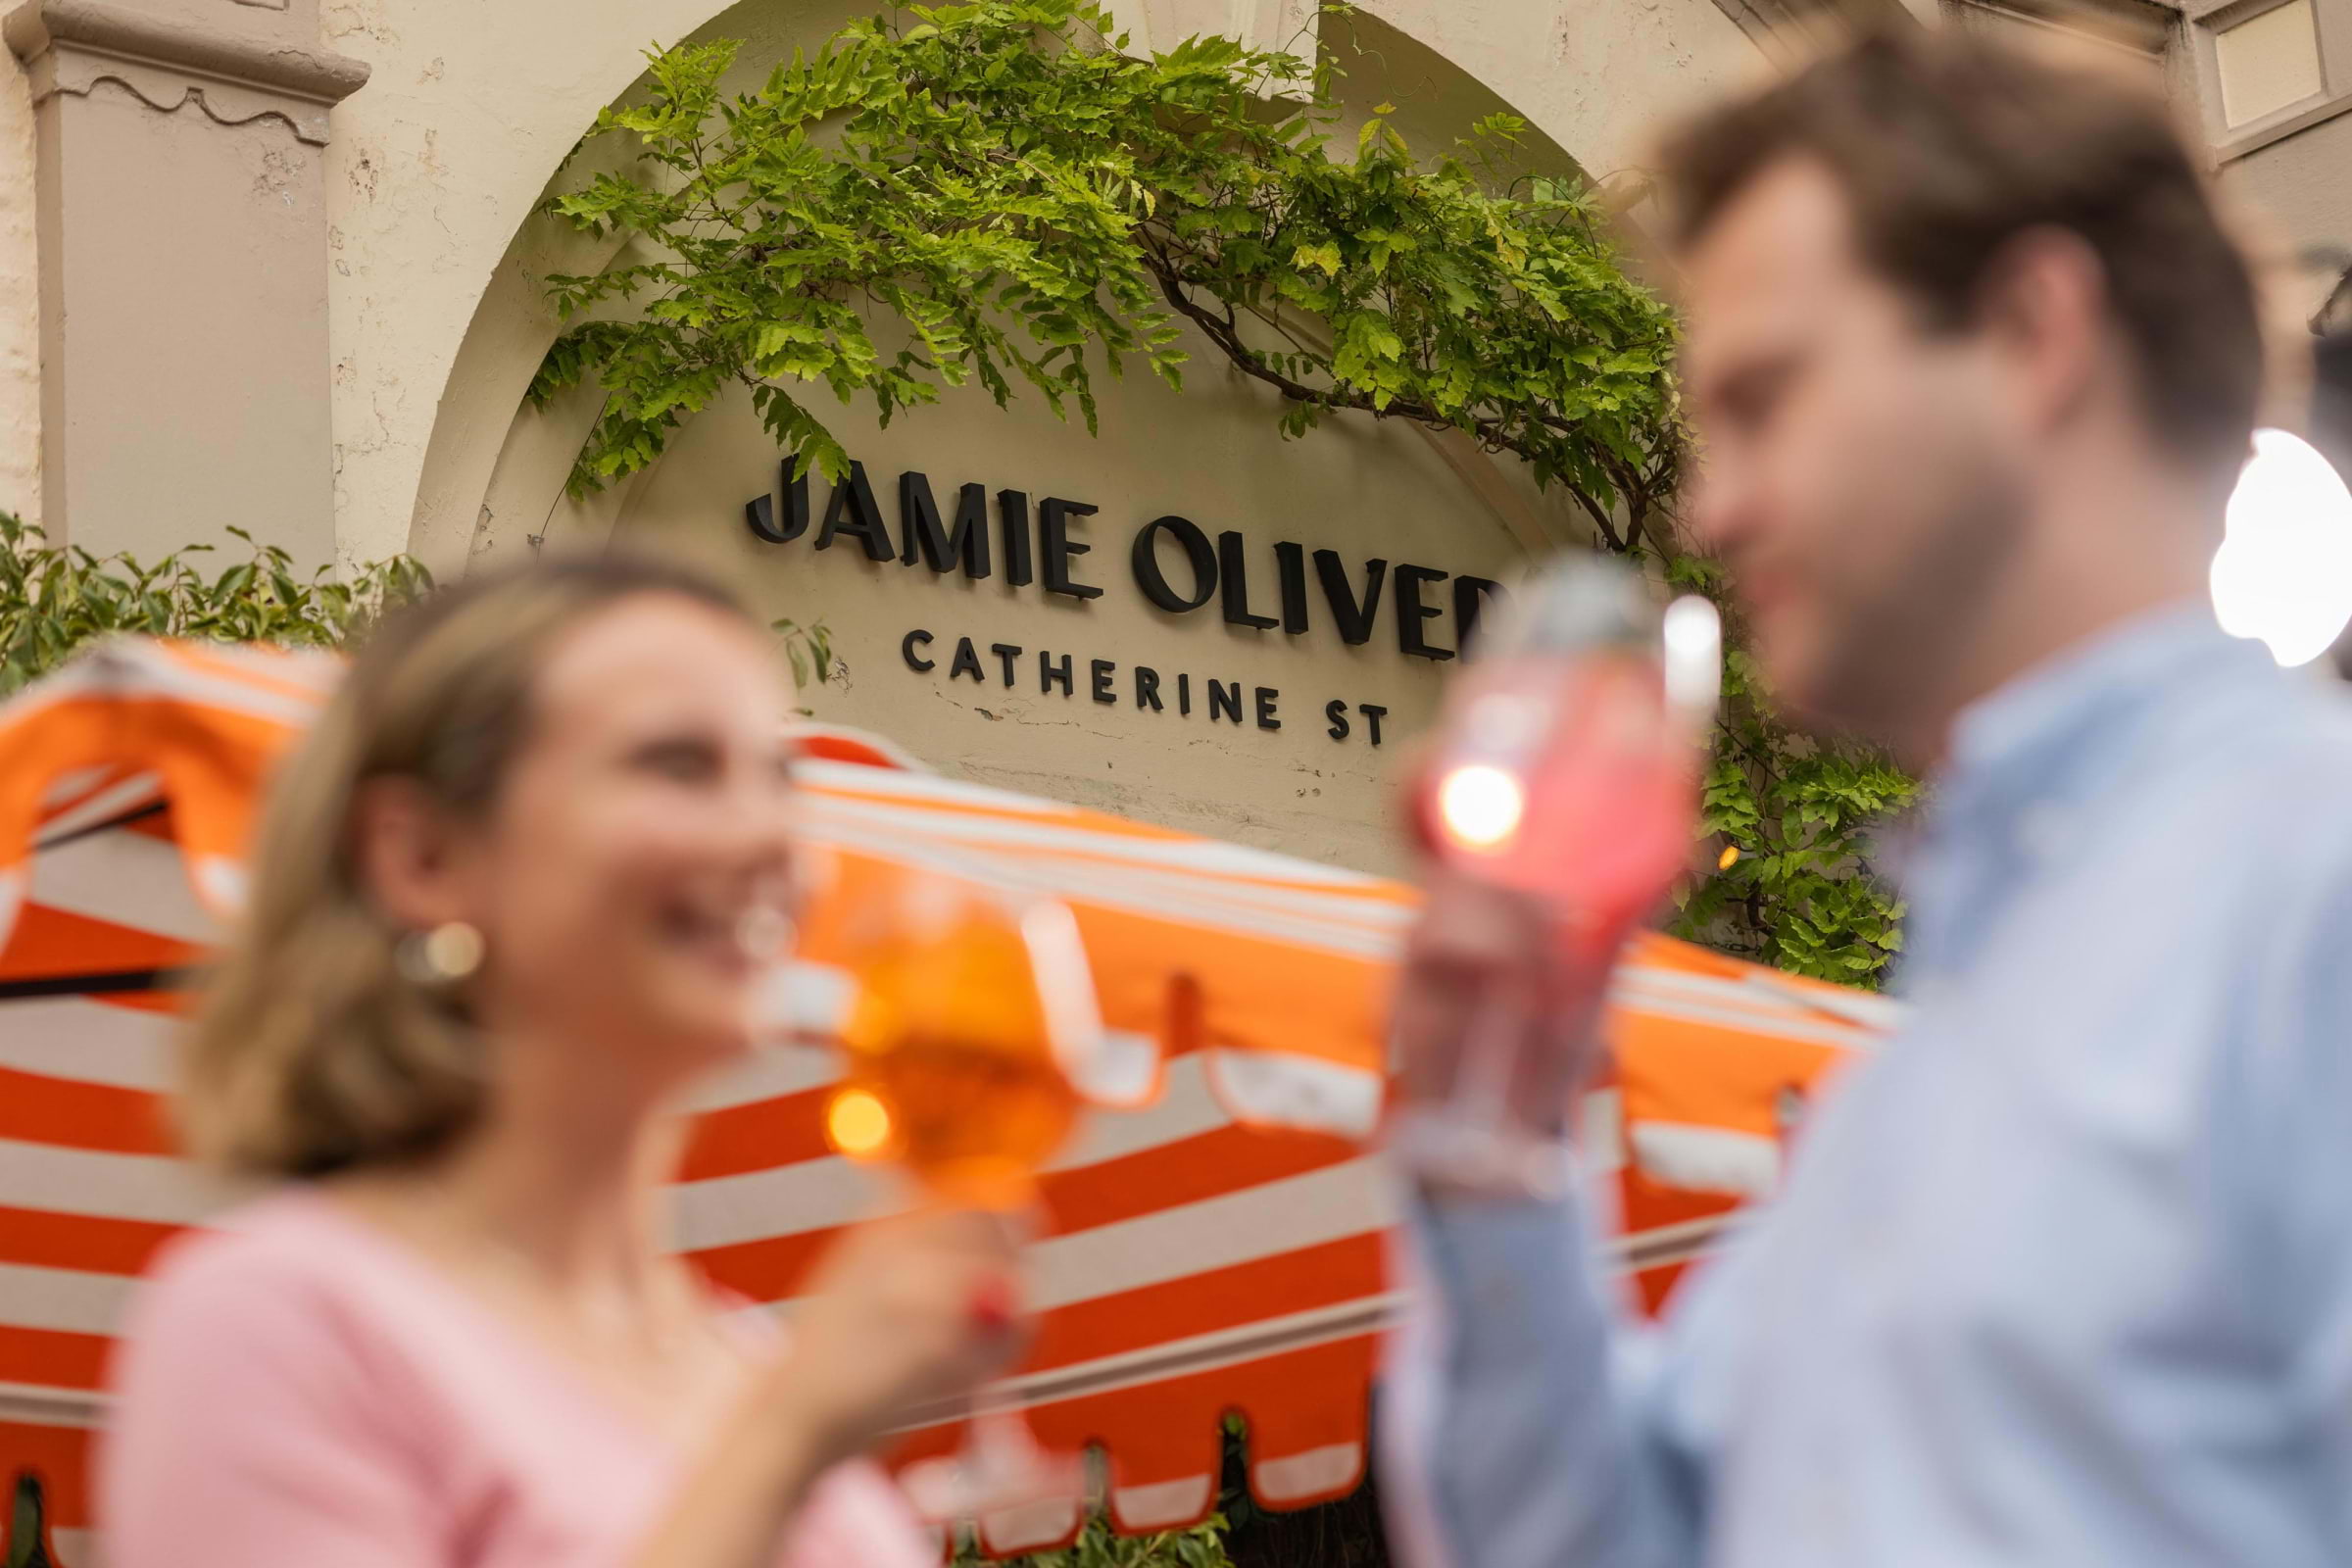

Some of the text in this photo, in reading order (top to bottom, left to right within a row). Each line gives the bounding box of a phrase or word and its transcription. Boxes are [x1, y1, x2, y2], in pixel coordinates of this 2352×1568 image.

[745, 451, 1104, 601] JAMIE
[901, 627, 1389, 746] CATHERINE ST
